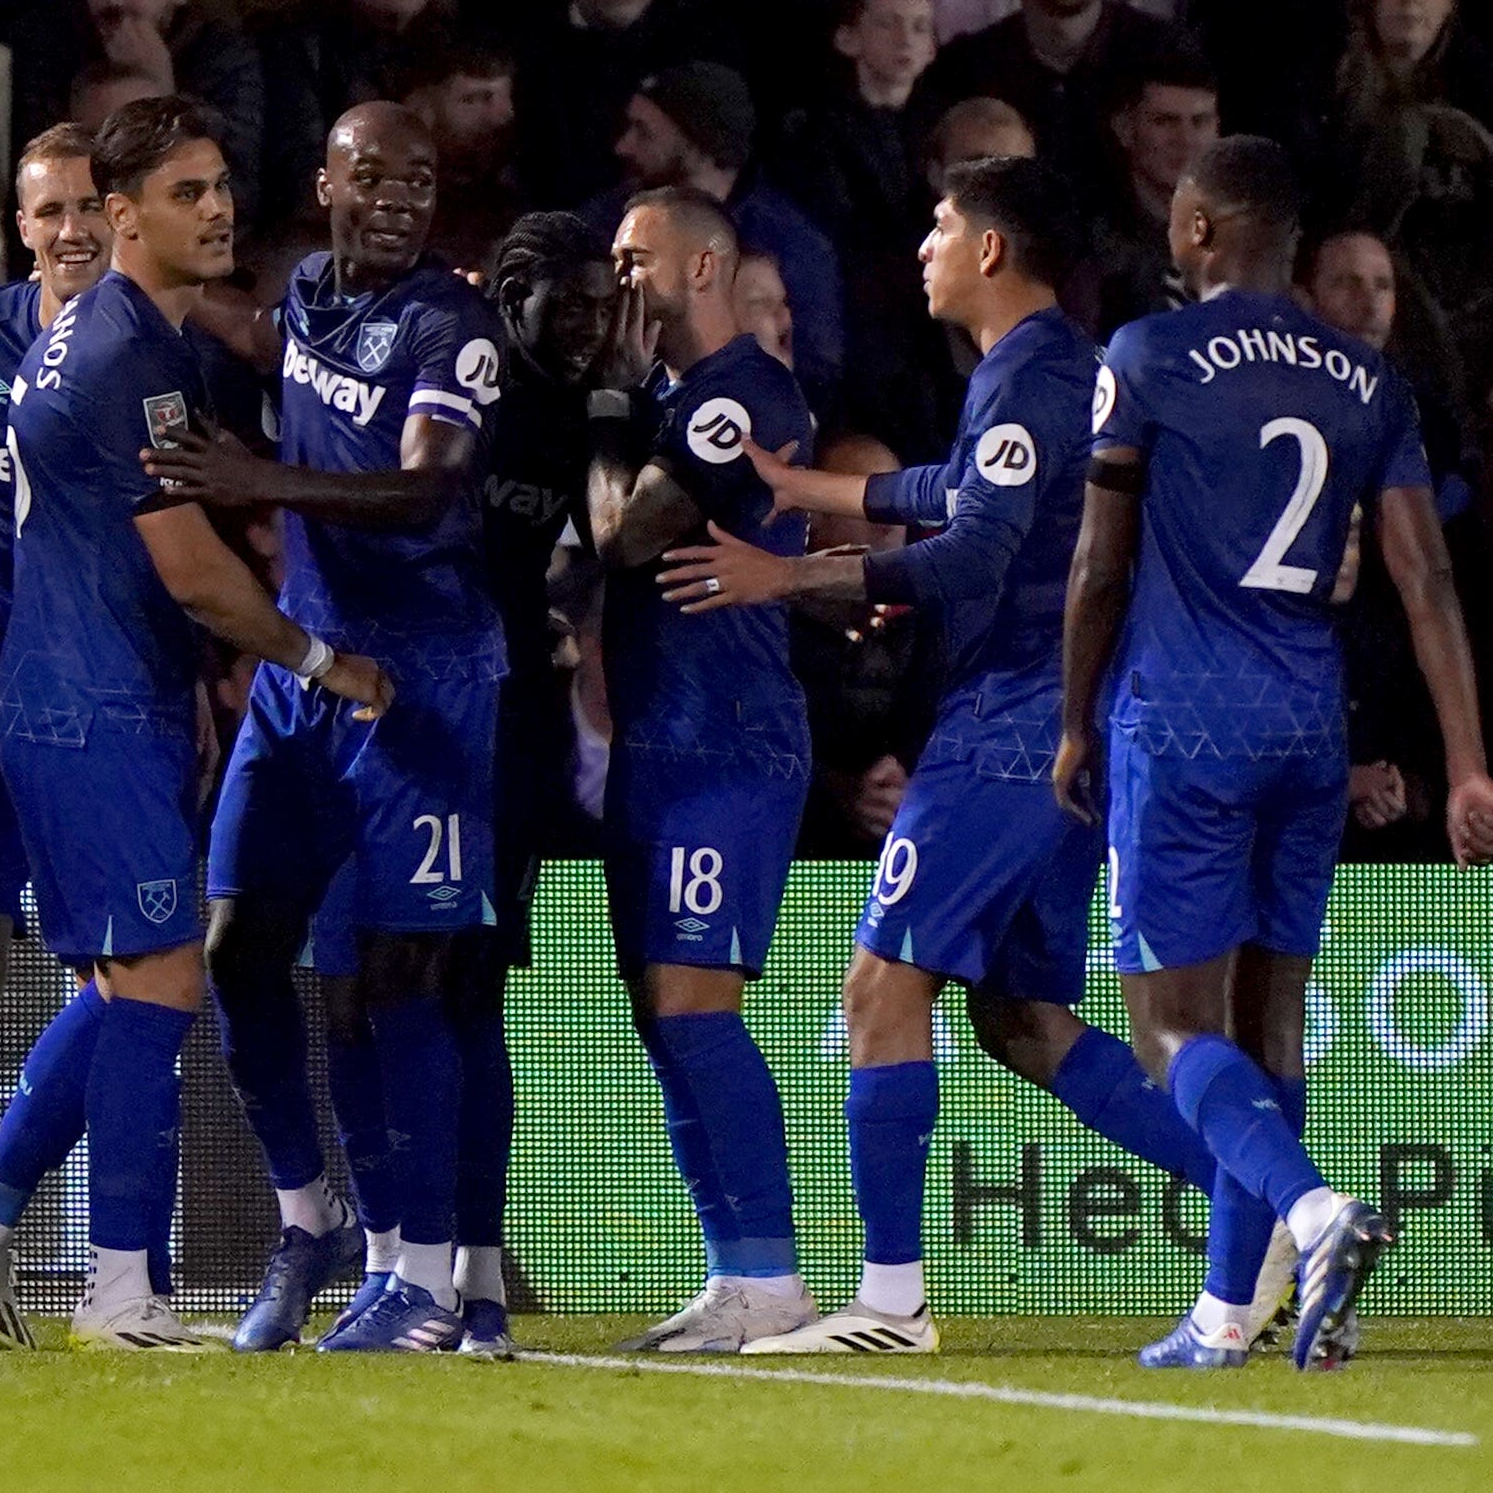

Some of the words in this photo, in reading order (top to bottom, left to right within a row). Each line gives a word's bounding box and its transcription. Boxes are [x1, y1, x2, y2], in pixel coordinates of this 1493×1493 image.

[1189, 329, 1377, 404] JOHNSON
[693, 414, 742, 450] JD
[983, 439, 1029, 471] JD
[1239, 417, 1328, 594] 2
[409, 813, 463, 884] 21
[669, 846, 724, 916] 18
